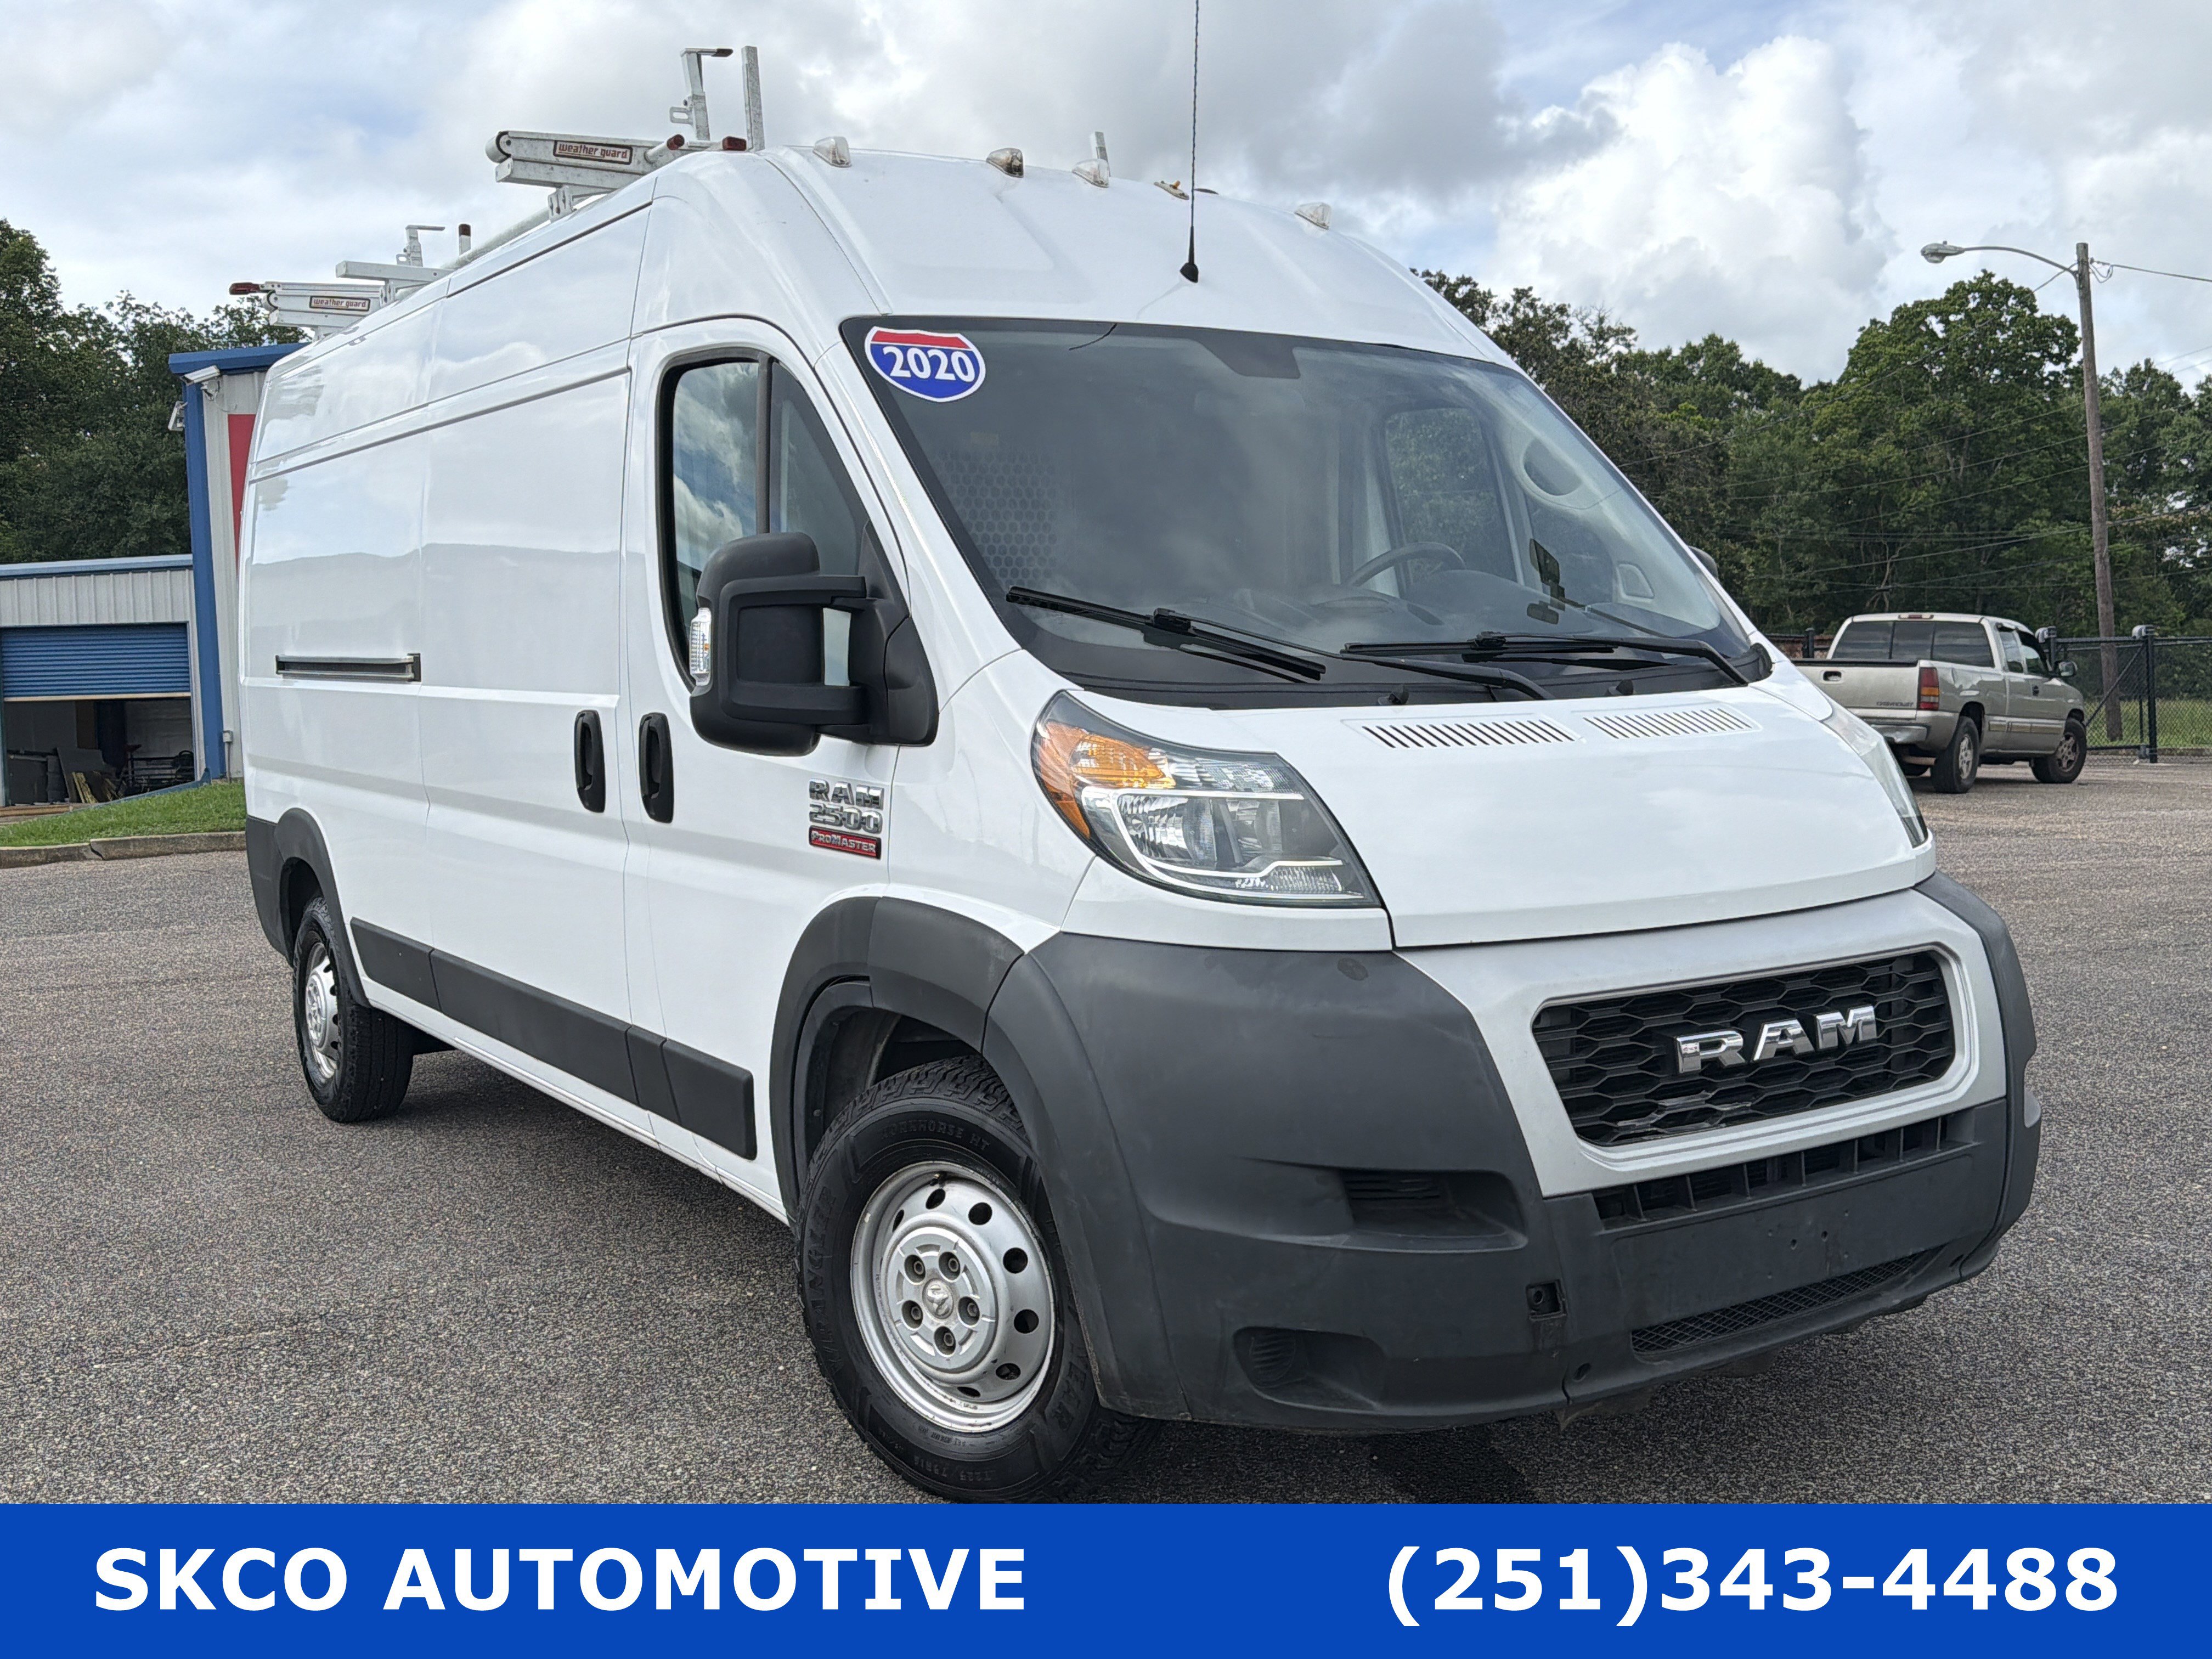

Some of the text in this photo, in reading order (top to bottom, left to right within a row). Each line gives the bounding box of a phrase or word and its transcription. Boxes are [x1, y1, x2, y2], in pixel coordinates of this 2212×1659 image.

[558, 143, 628, 159] weather guard
[345, 300, 366, 308] guard
[883, 346, 975, 382] 2020
[809, 778, 885, 811] RAM
[809, 801, 884, 834] 2500
[1675, 1005, 1878, 1074] RAM
